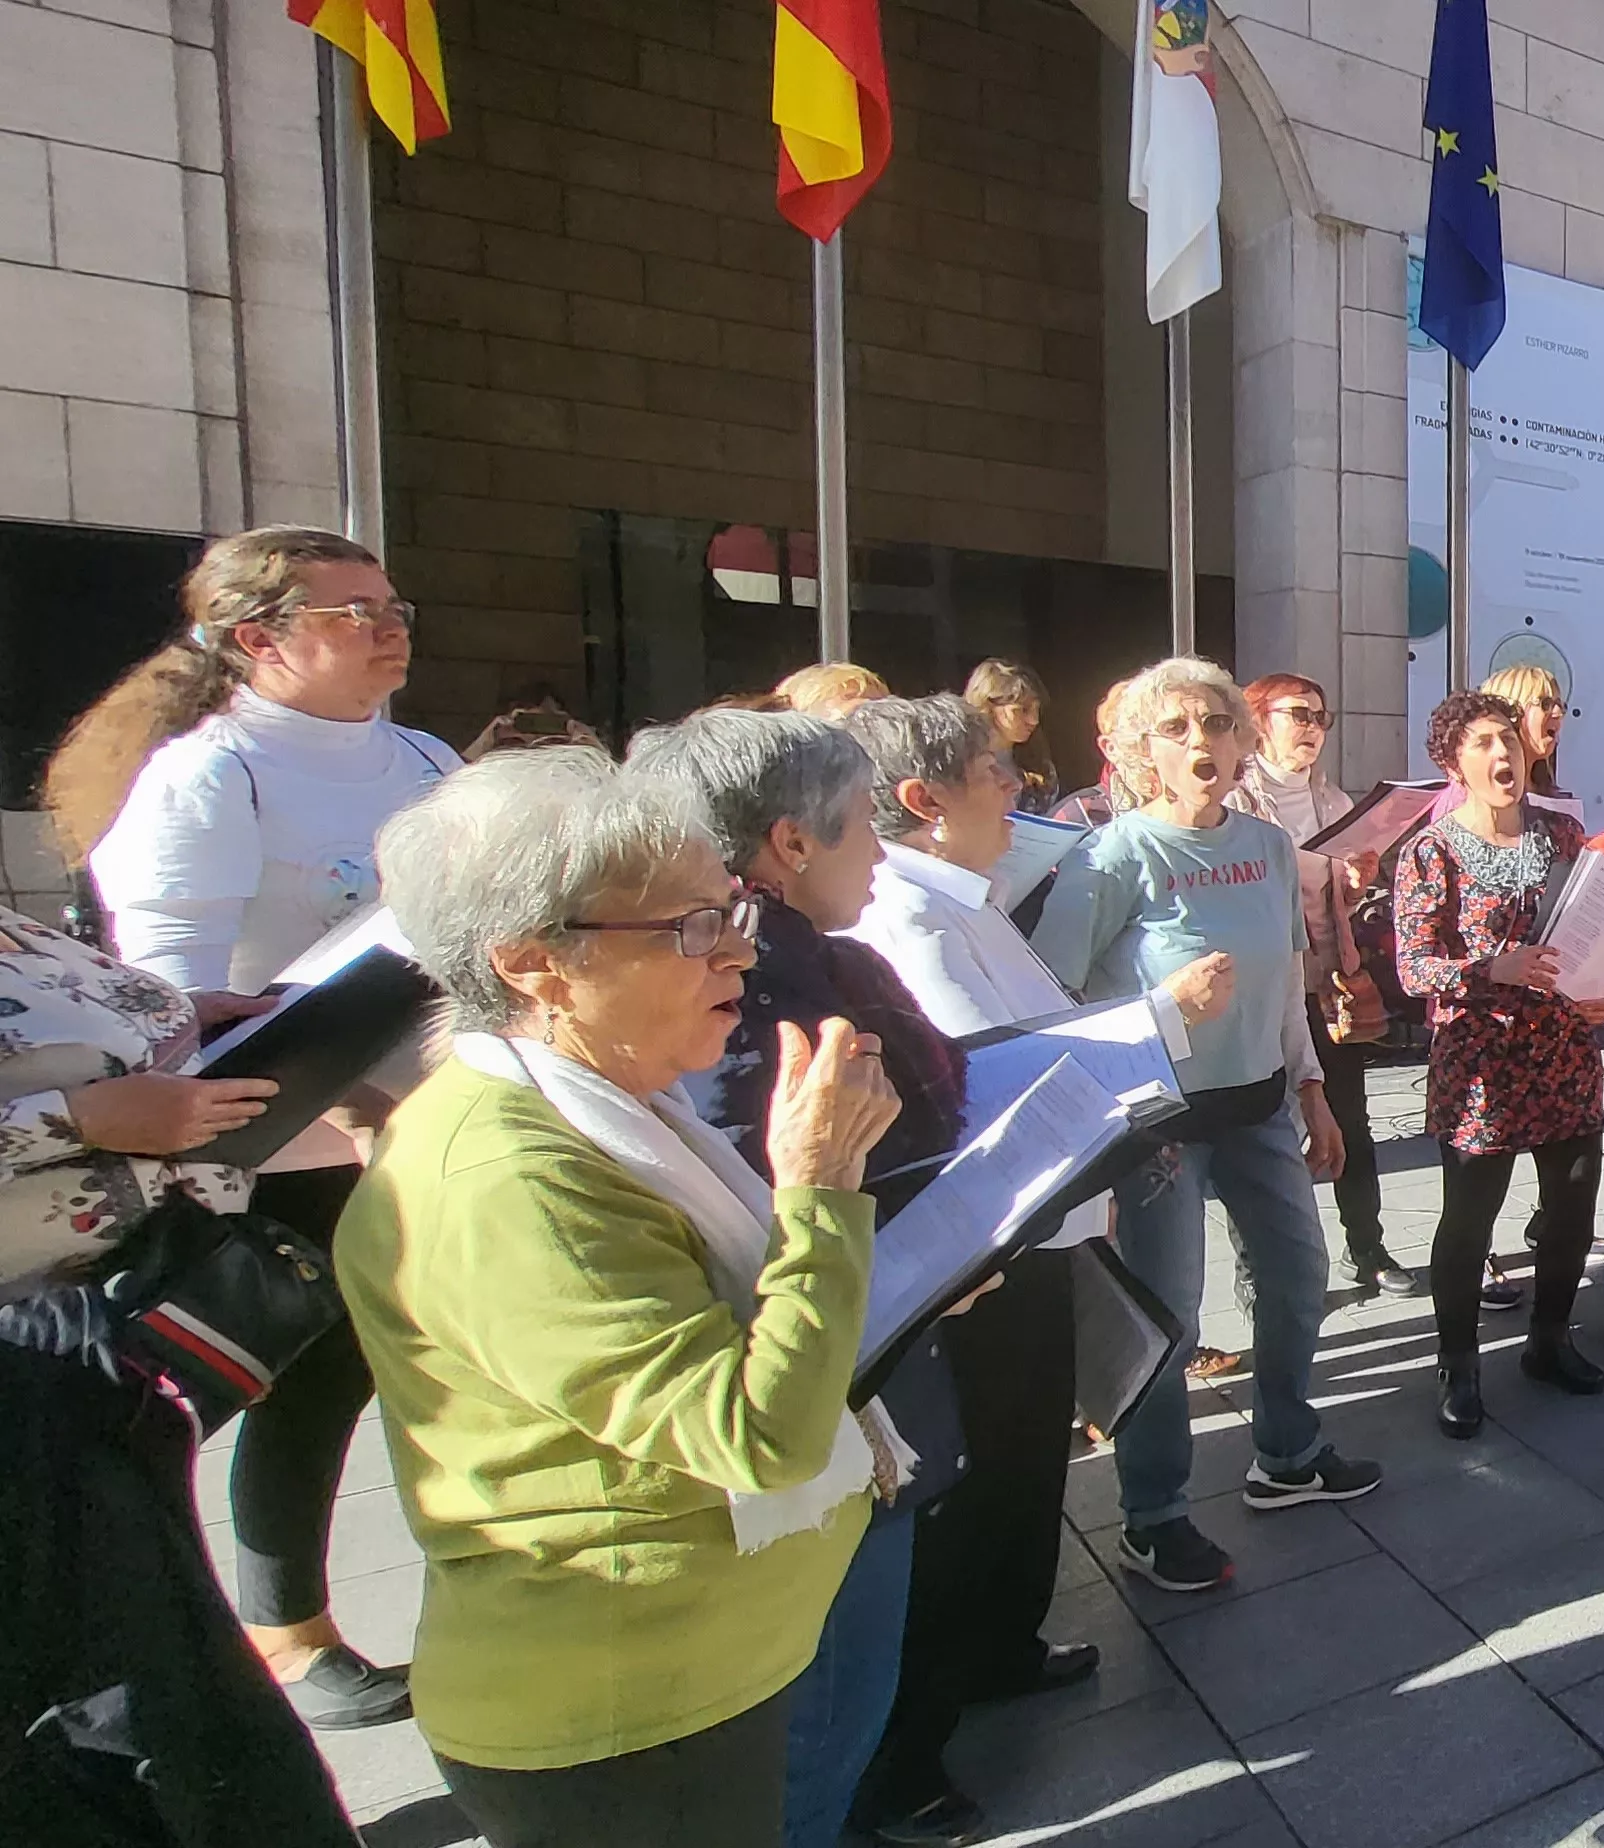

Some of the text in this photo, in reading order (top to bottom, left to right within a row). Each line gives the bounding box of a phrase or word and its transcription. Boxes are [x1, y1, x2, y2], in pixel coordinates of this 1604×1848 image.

[1525, 335, 1589, 360] ESTHER PIZARRO
[1440, 400, 1493, 421] EGÍAS
[1415, 415, 1493, 440] FRAGMADAS
[1525, 419, 1598, 443] CONTAMINACIÓN
